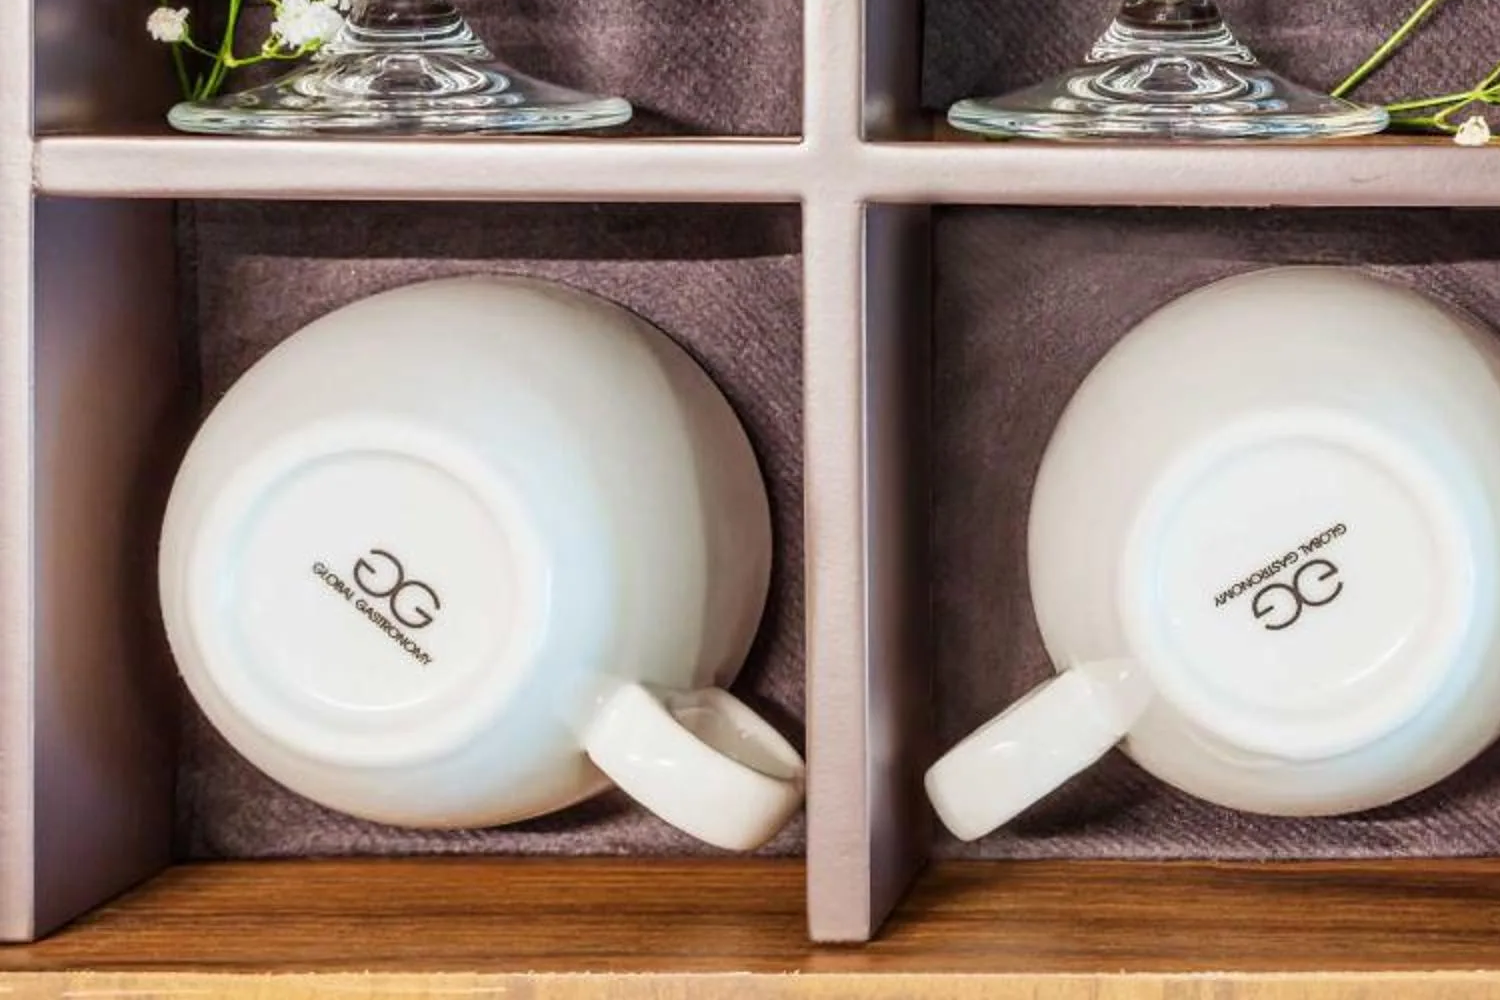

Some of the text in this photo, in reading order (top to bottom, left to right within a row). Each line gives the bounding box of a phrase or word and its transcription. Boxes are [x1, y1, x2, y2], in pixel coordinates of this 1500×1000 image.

[1213, 523, 1347, 607] GLOBAL GASTRONOMY
[312, 562, 433, 665] GLOBAL GASTRONOMY
